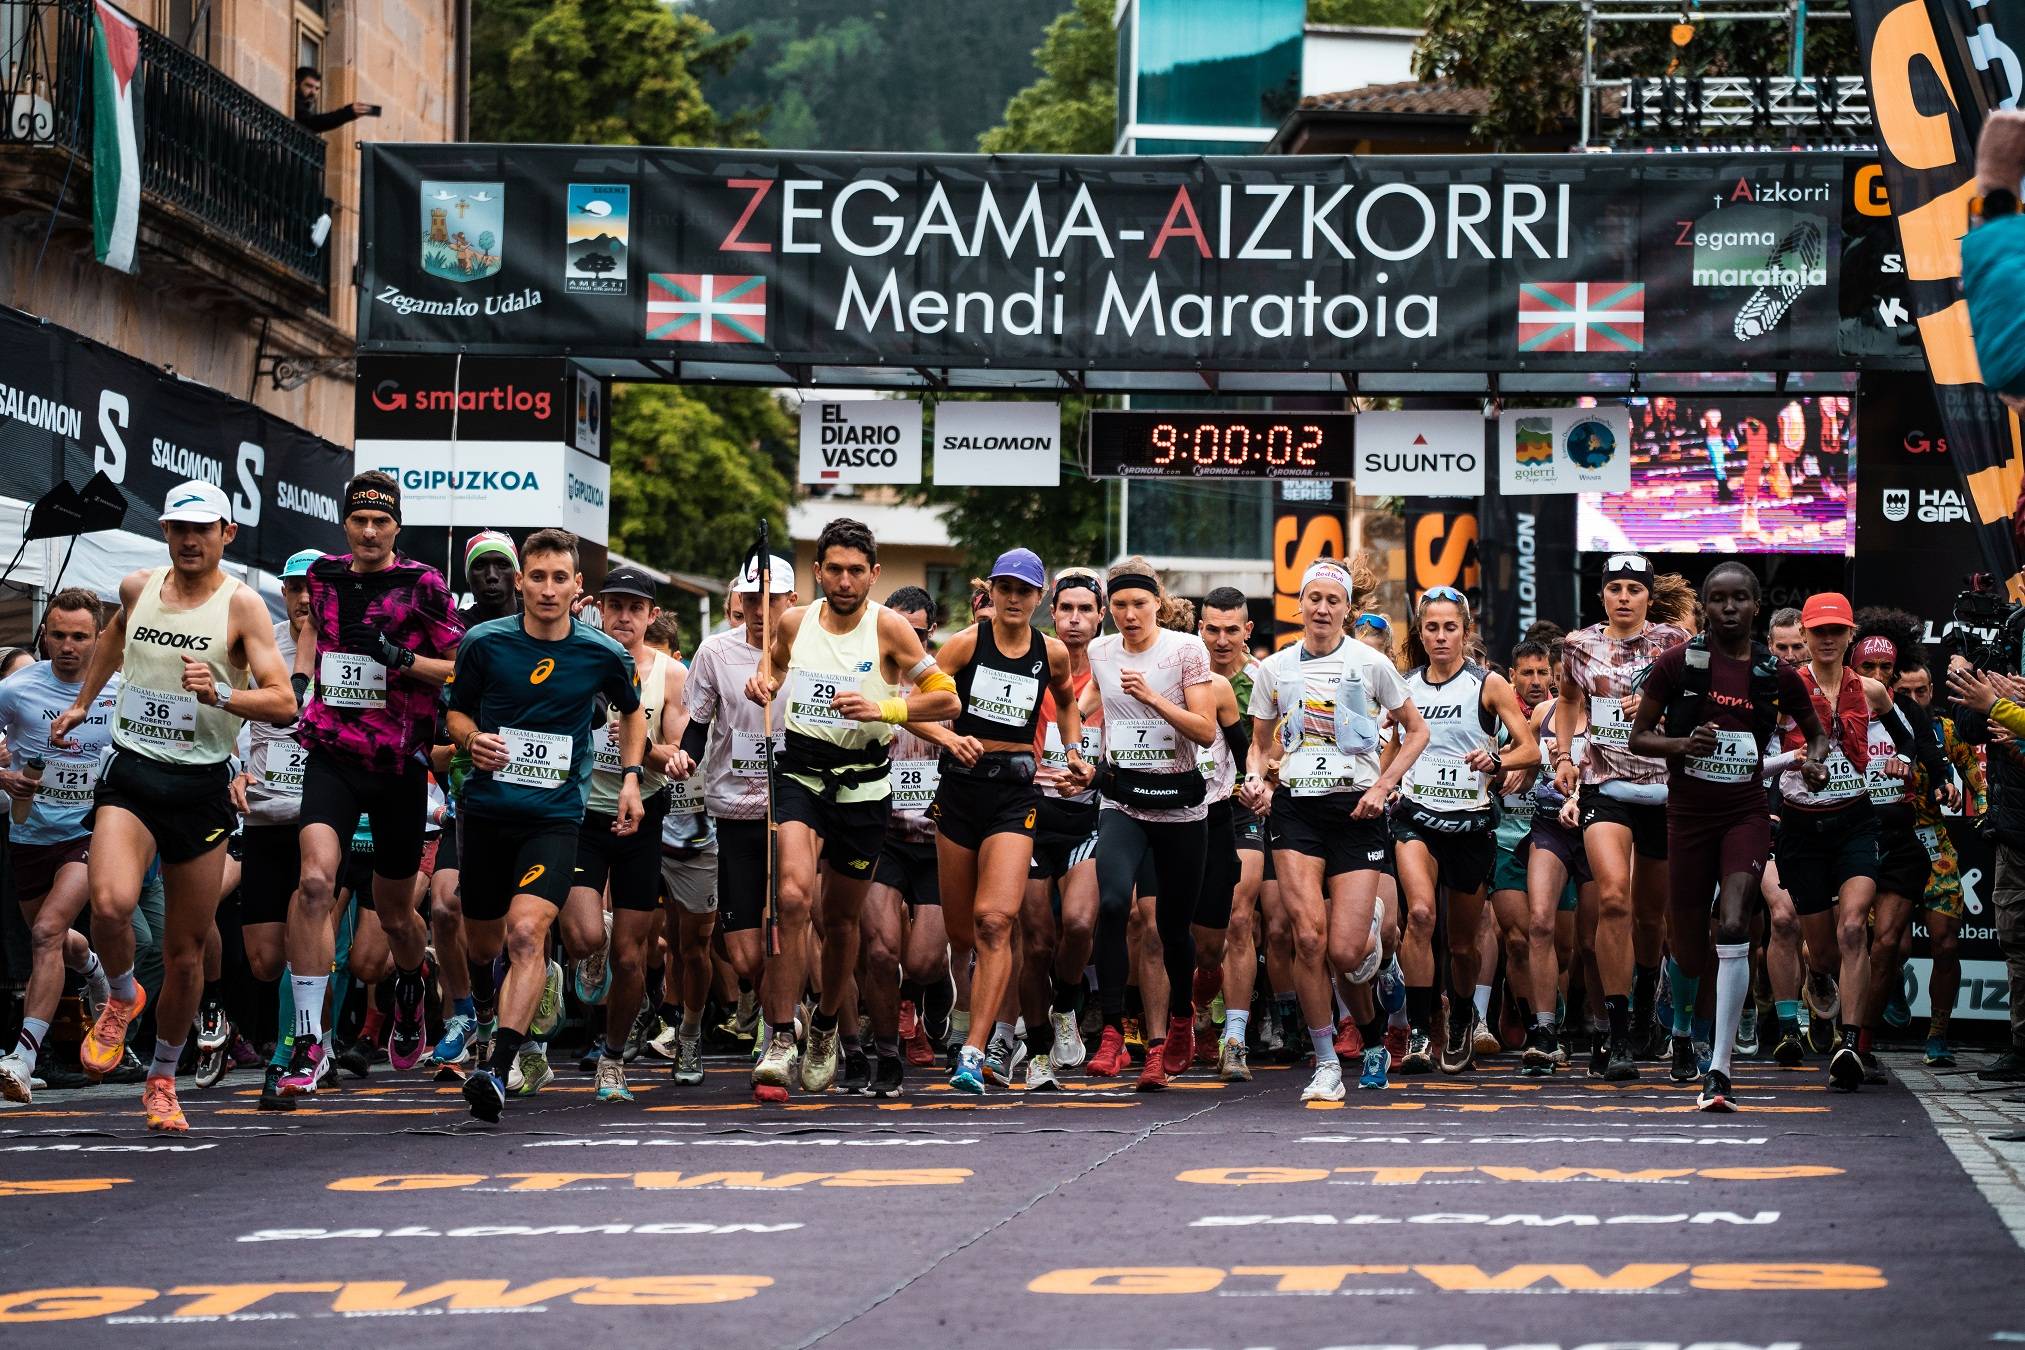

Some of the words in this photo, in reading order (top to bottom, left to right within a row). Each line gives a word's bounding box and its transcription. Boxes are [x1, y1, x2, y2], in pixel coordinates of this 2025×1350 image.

[1731, 176, 1829, 202] Aizkorri
[718, 178, 1570, 261] ZEGAMA-AIZKORRI
[1675, 221, 1776, 251] Zegama
[1693, 264, 1827, 286] maratoia
[376, 285, 479, 317] Zegamako
[484, 288, 543, 315] Udala
[835, 265, 1066, 335] Mendi
[1095, 270, 1438, 338] Maratoia
[415, 385, 551, 420] smartlog
[0, 383, 82, 440] SALOMON
[821, 404, 848, 423] EL
[821, 426, 901, 445] DIARIO
[943, 437, 1052, 450] SALOMON
[1152, 424, 1323, 466] 9:00:02
[151, 437, 223, 488] SALOMON
[822, 448, 898, 468] VASCO
[1365, 453, 1477, 473] SUUNTO
[403, 470, 539, 490] GIPUZKOA
[277, 480, 340, 525] SALOMON
[1282, 488, 1333, 500] SERIES
[133, 626, 212, 651] BROOKS
[341, 665, 362, 680] 31
[129, 685, 193, 703] ZEGAMA-AIZKORRI
[325, 686, 378, 699] ZEGAMA
[813, 683, 836, 699] 29
[1003, 684, 1012, 698] 1
[975, 698, 1027, 719] ZEGAMA
[995, 696, 1012, 704] SARA
[144, 702, 170, 719] 36
[798, 704, 841, 718] ZEGAM
[140, 715, 172, 726] ROBERTO
[127, 720, 186, 741] ZEGAMA
[1137, 730, 1147, 742] 7
[1598, 727, 1632, 739] ZEGA
[522, 742, 548, 759] 30
[1116, 750, 1168, 760] ZEGAMA
[1716, 742, 1737, 756] 14
[516, 757, 551, 766] BENJAMIN
[1316, 757, 1326, 770] 2
[1693, 760, 1748, 775] ZEGAMA
[1830, 761, 1850, 775] 16
[56, 771, 88, 785] 121
[502, 763, 561, 780] ZEGAMA
[901, 771, 922, 784] 28
[1438, 767, 1458, 781] 11
[1132, 786, 1179, 796] SALOMON
[1296, 778, 1346, 788] ZEGAMA
[1420, 784, 1471, 799] ZEGAMA
[41, 786, 95, 801] ZEGAMA
[1868, 787, 1899, 798] GAMA
[1412, 811, 1472, 833] FUGA
[326, 1168, 975, 1191] GTWS
[1187, 1211, 1781, 1227] SALOMON
[236, 1223, 805, 1242] SALOMON
[1026, 1263, 1888, 1295] GTWS
[0, 1275, 775, 1323] GTWS
